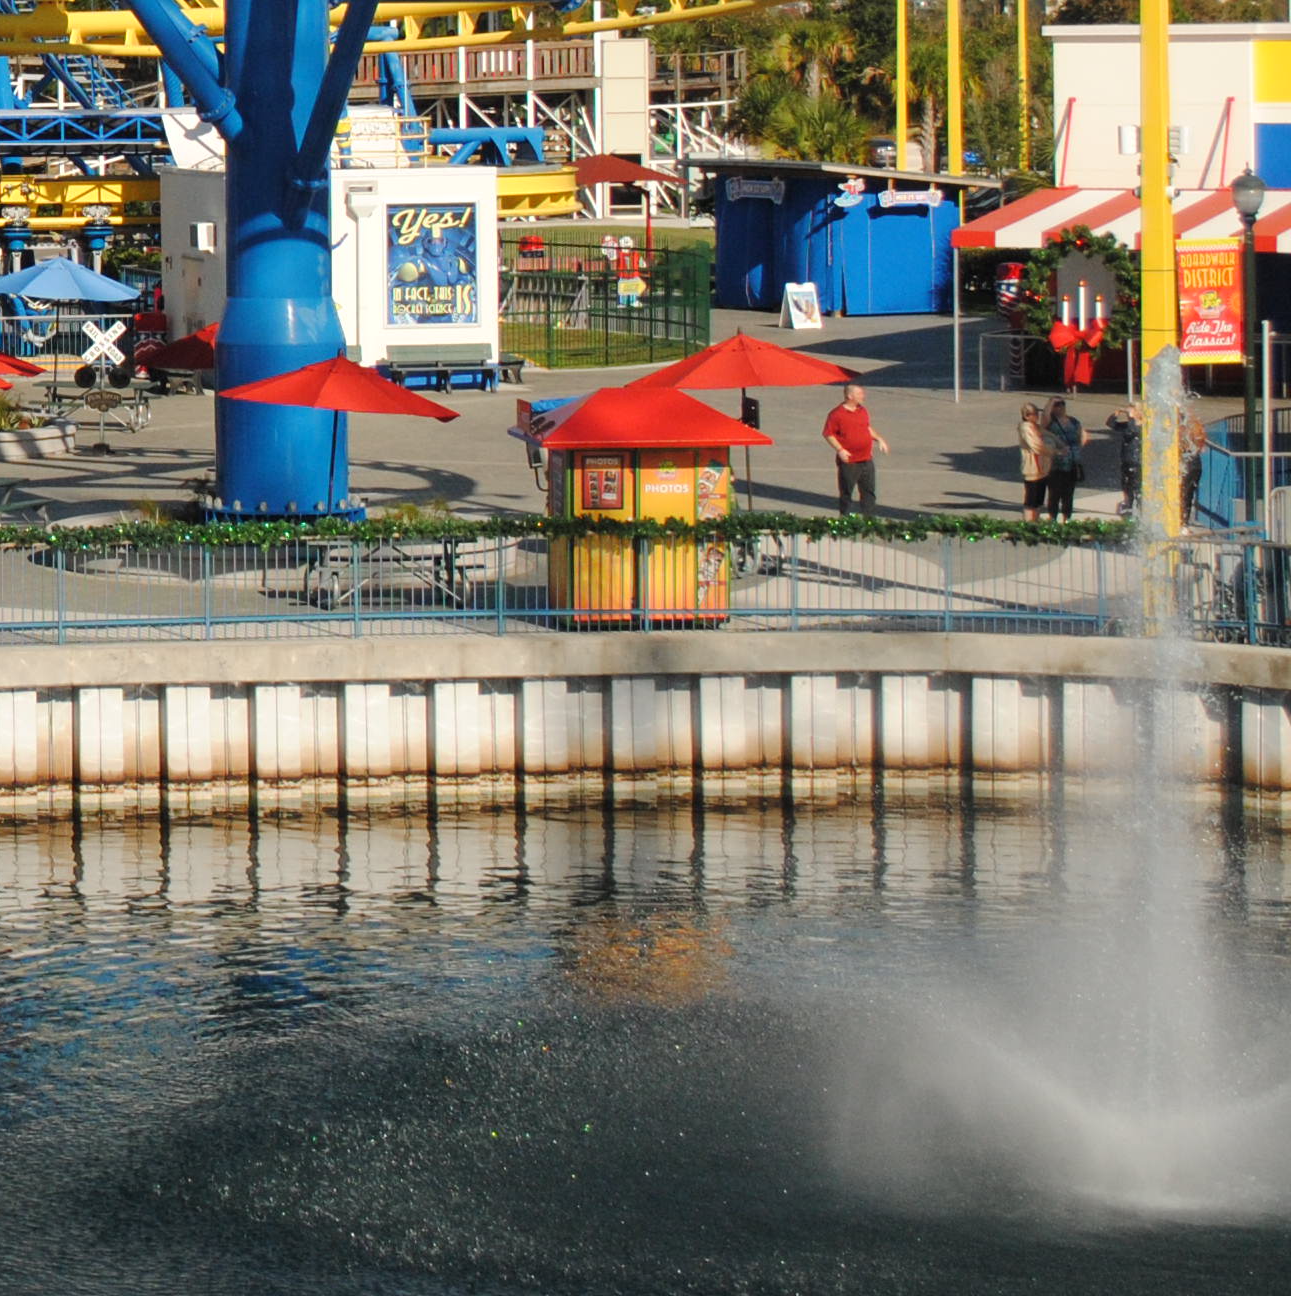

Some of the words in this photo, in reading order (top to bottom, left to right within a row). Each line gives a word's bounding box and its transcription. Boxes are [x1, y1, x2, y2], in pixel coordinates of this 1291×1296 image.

[392, 207, 472, 245] Yes!
[1180, 252, 1235, 267] BOARDWALK
[1183, 267, 1235, 288] DISTRICT
[456, 284, 472, 314] IS
[1186, 321, 1210, 334] Ride
[1211, 319, 1233, 335] The
[1183, 333, 1236, 350] Classics!
[585, 458, 619, 466] PHOTOS
[644, 483, 690, 494] PHOTOS
